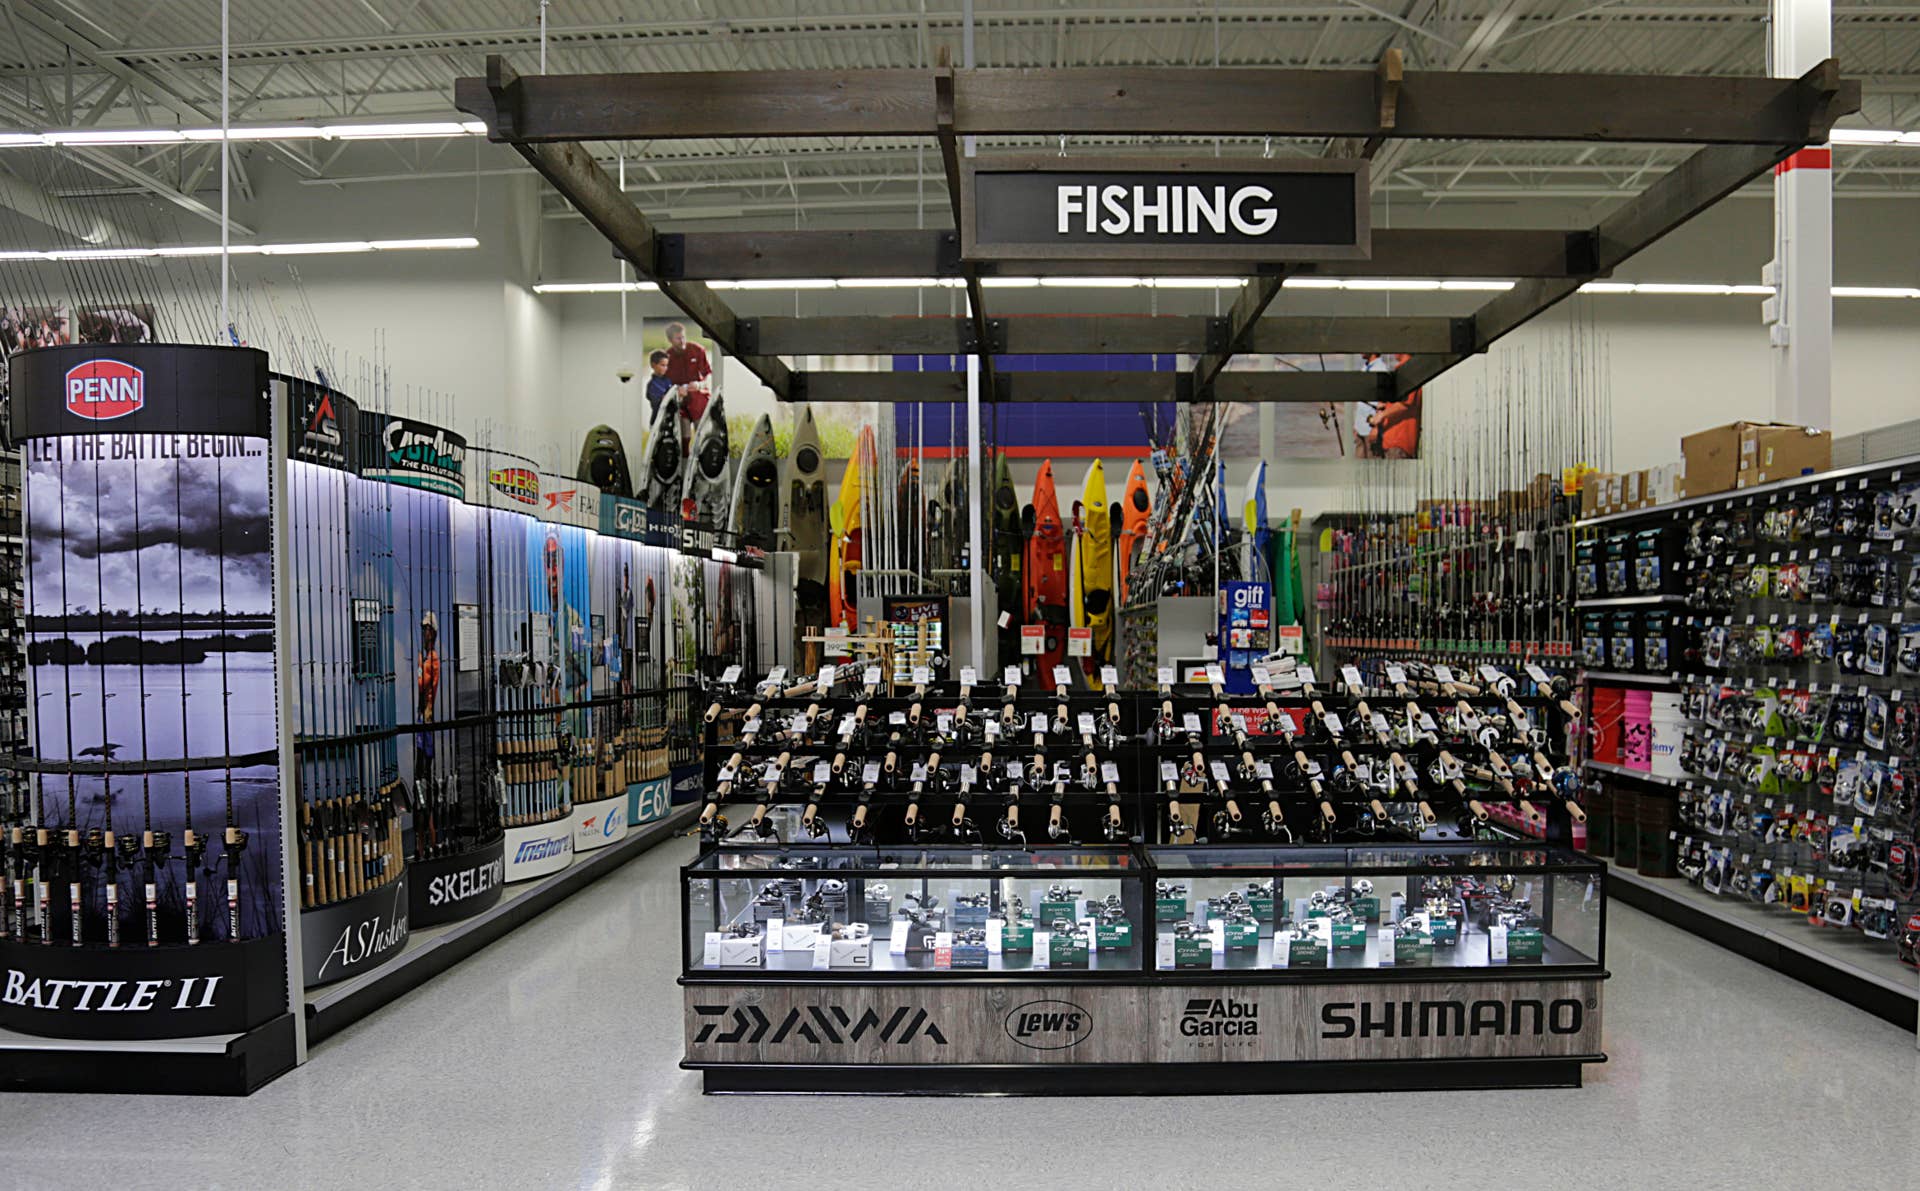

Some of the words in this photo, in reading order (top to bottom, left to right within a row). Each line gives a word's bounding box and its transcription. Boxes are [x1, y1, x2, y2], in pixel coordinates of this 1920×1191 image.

[1057, 184, 1279, 236] FISHING
[69, 376, 138, 403] PENN
[32, 437, 61, 462] LET
[72, 436, 105, 461] THE
[111, 434, 180, 460] BATTLE
[401, 459, 420, 470] THE
[911, 603, 940, 615] LIVE
[1234, 585, 1264, 608] gift
[911, 610, 939, 621] BAIT
[638, 778, 670, 821] E6X
[171, 976, 223, 1009] II
[1209, 998, 1258, 1018] Abu
[1321, 1000, 1583, 1039] SHIMANO
[693, 1006, 948, 1044] DAIWA
[1180, 1016, 1258, 1037] Garcia
